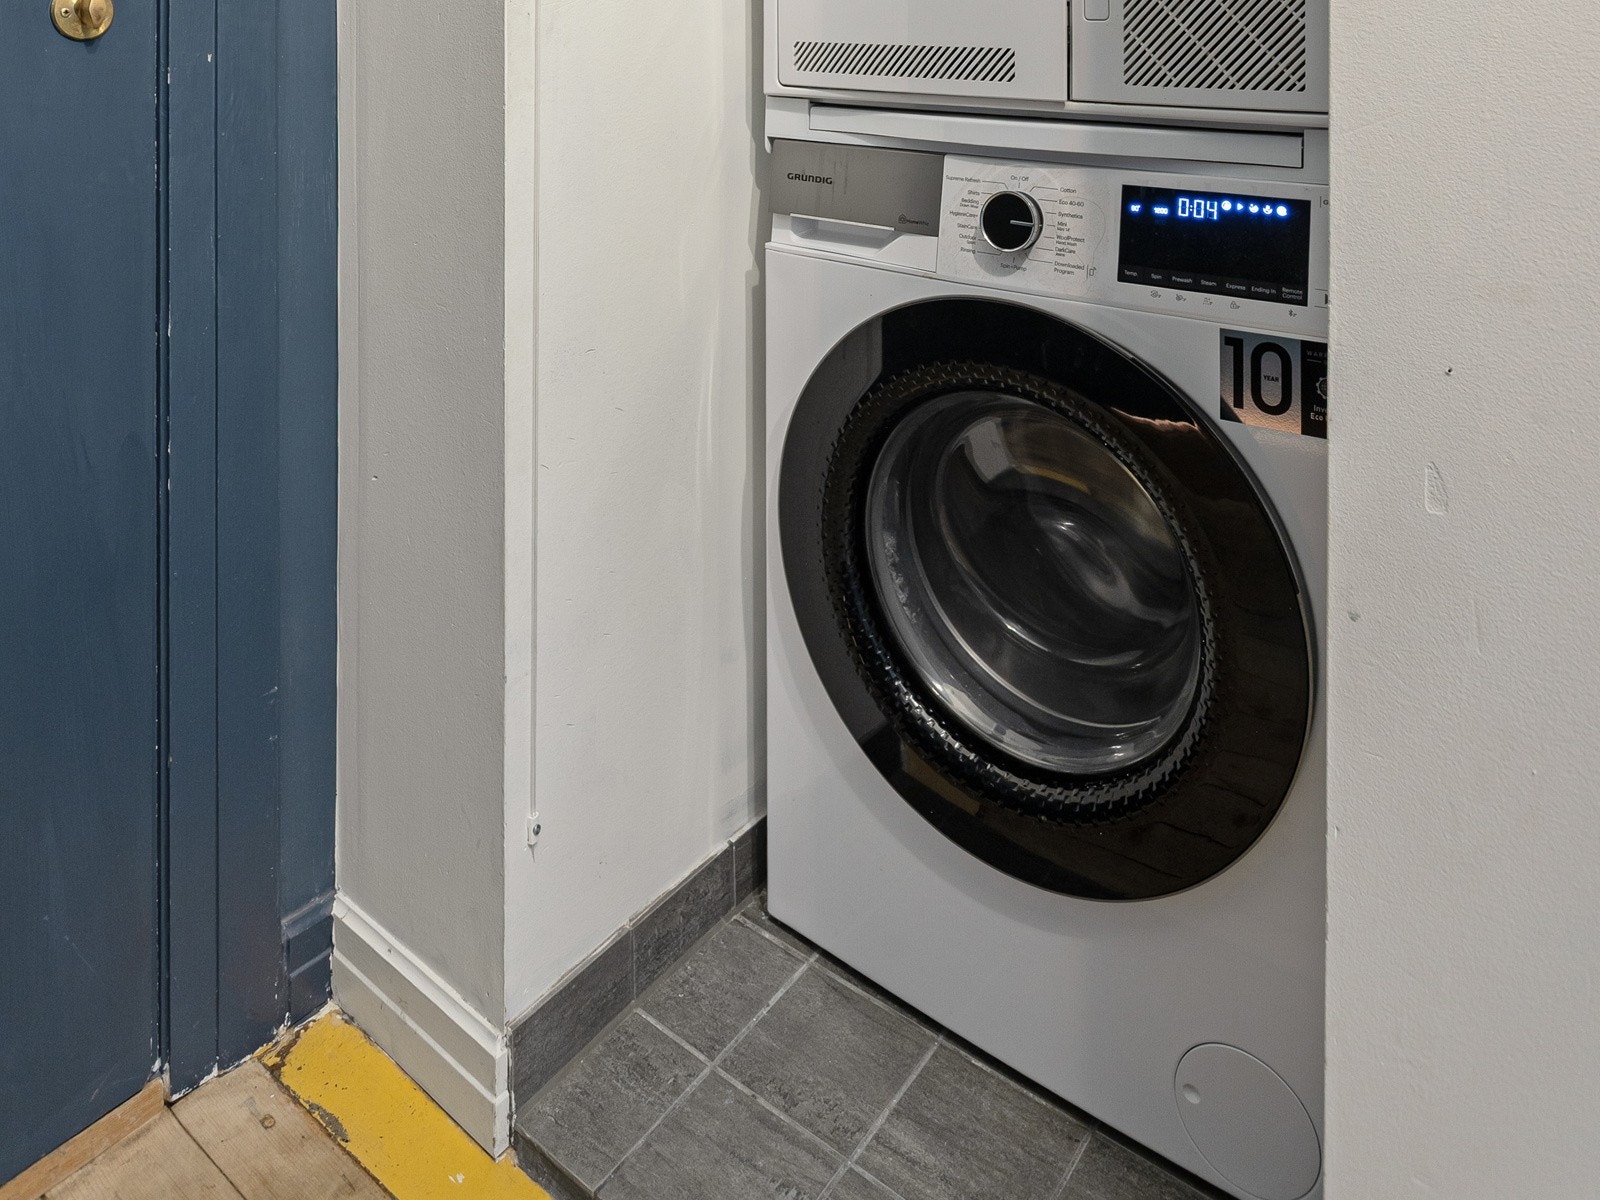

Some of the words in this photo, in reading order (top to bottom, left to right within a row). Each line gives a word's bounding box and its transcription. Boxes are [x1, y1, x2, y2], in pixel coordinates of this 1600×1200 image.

[787, 172, 833, 185] GRUNDIG
[1059, 186, 1077, 194] Cotton
[1178, 198, 1218, 220] 0:04
[1058, 211, 1083, 219] Synthetics
[1054, 261, 1085, 270] Downloaded
[1054, 267, 1075, 276] Program
[1124, 269, 1138, 277] Temp
[1171, 275, 1193, 284] Prewash
[1200, 279, 1217, 287] Steam
[1225, 282, 1246, 291] Express
[1251, 285, 1270, 295] Ending
[1282, 286, 1303, 295] Remote
[1282, 293, 1303, 301] Control
[1224, 336, 1293, 416] 10
[1263, 374, 1280, 382] YEAR
[1310, 412, 1324, 421] Eco
